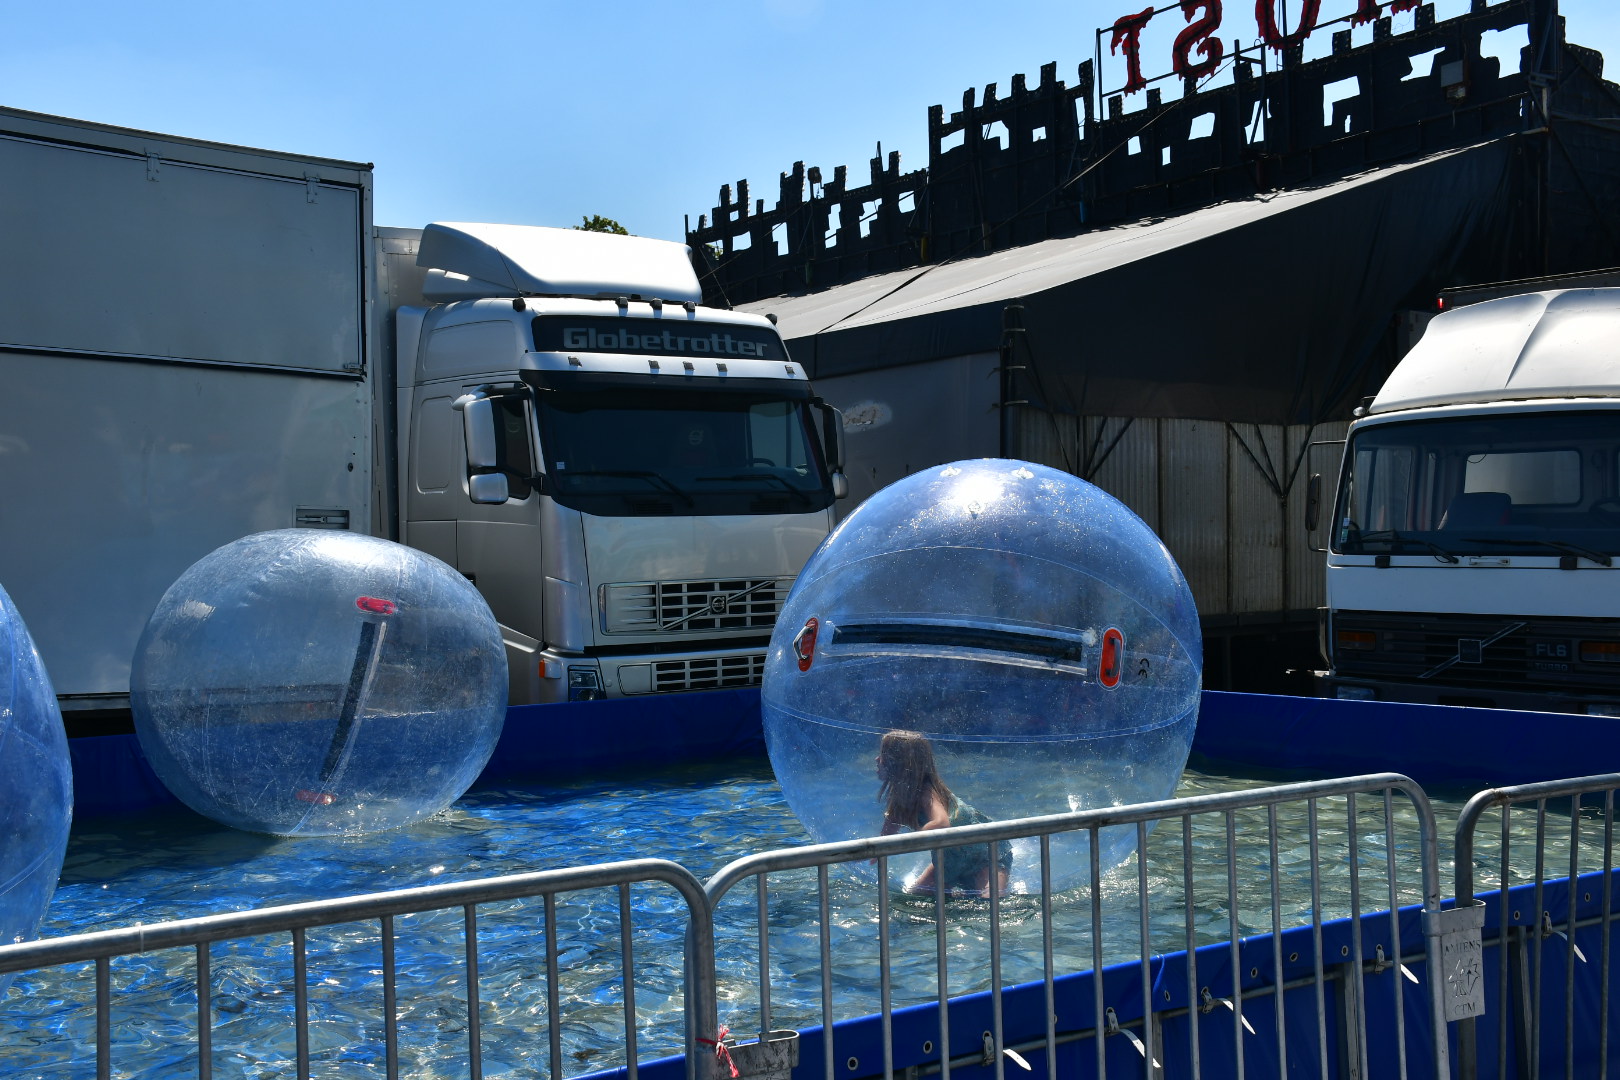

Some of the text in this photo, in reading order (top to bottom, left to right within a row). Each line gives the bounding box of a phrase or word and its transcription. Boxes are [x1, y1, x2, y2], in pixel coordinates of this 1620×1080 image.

[563, 327, 768, 357] Globetrotter
[1535, 643, 1567, 657] FL6
[1535, 662, 1568, 671] TURBO
[1444, 940, 1481, 956] AMIENS
[1454, 1002, 1476, 1015] CTM
